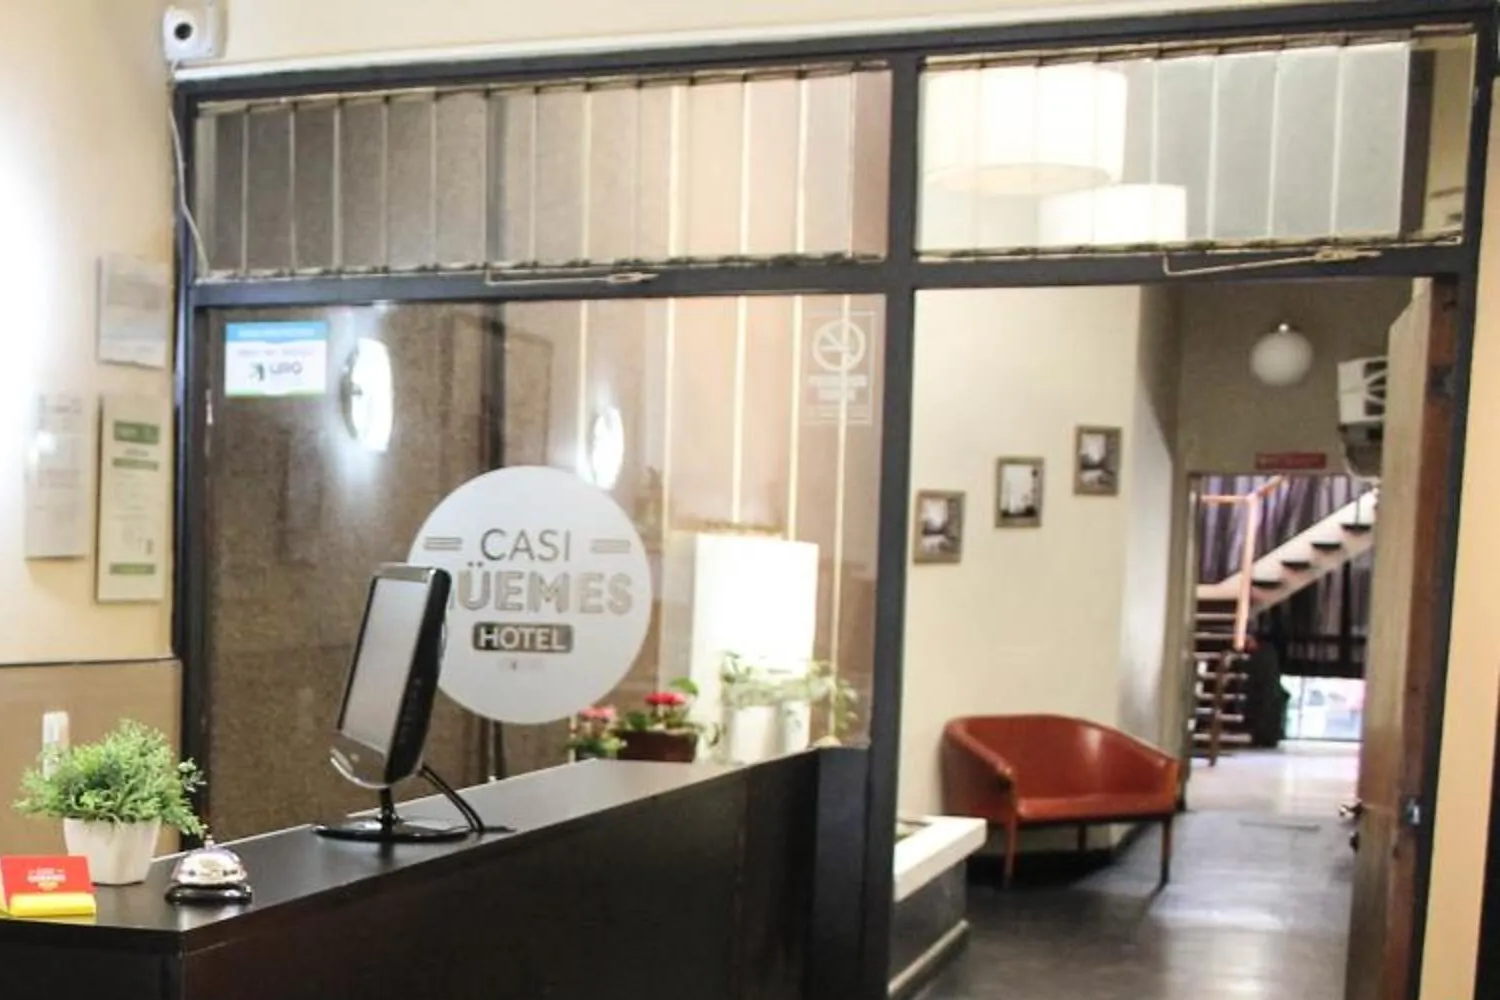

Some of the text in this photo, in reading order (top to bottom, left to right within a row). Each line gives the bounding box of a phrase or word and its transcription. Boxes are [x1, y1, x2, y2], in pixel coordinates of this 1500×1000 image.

[480, 528, 572, 562] CASI
[448, 562, 633, 614] ÜEMES
[479, 626, 568, 651] HOTEL
